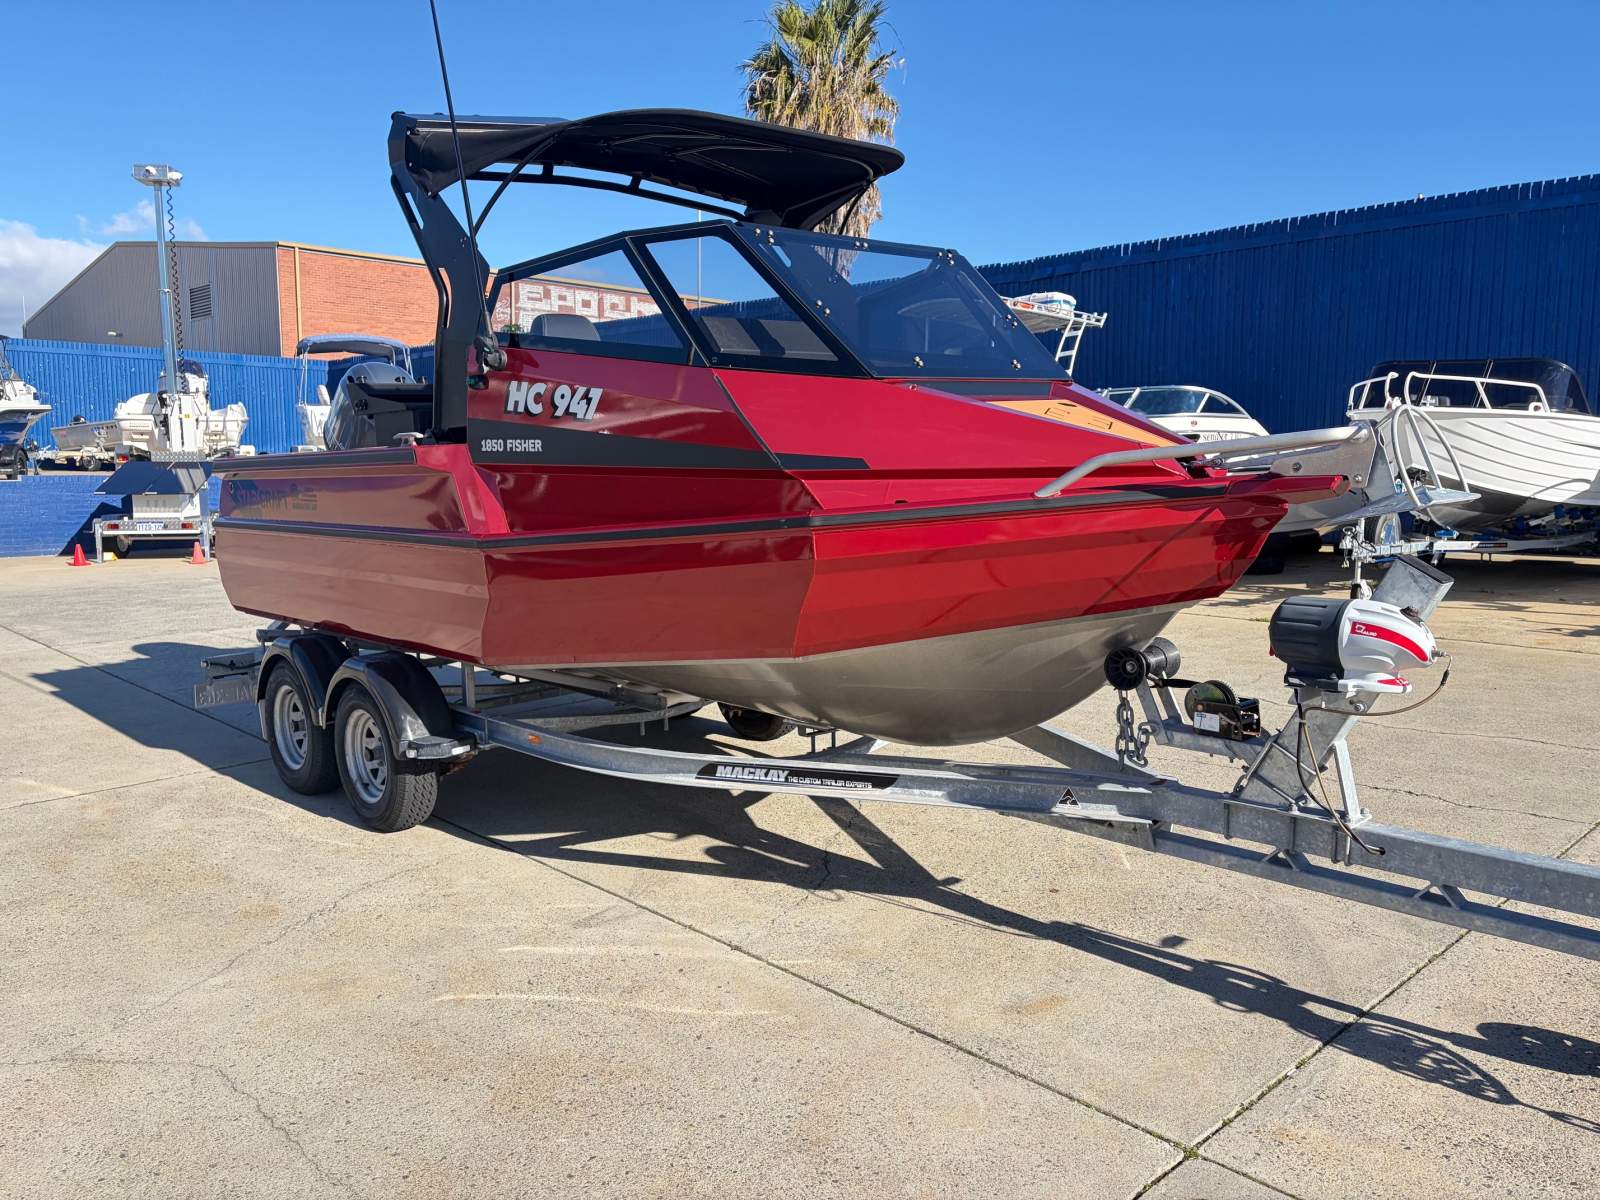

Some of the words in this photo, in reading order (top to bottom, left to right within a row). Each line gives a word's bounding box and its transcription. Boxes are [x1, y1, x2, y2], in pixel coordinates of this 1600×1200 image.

[505, 380, 547, 416] HC
[552, 384, 603, 420] 947
[481, 439, 504, 452] 1850
[506, 439, 543, 452] FISHER
[715, 765, 790, 782] MACKAY
[799, 777, 822, 785] CUSTOM
[822, 778, 845, 787] TRAILER
[845, 780, 873, 789] EXPERTS
